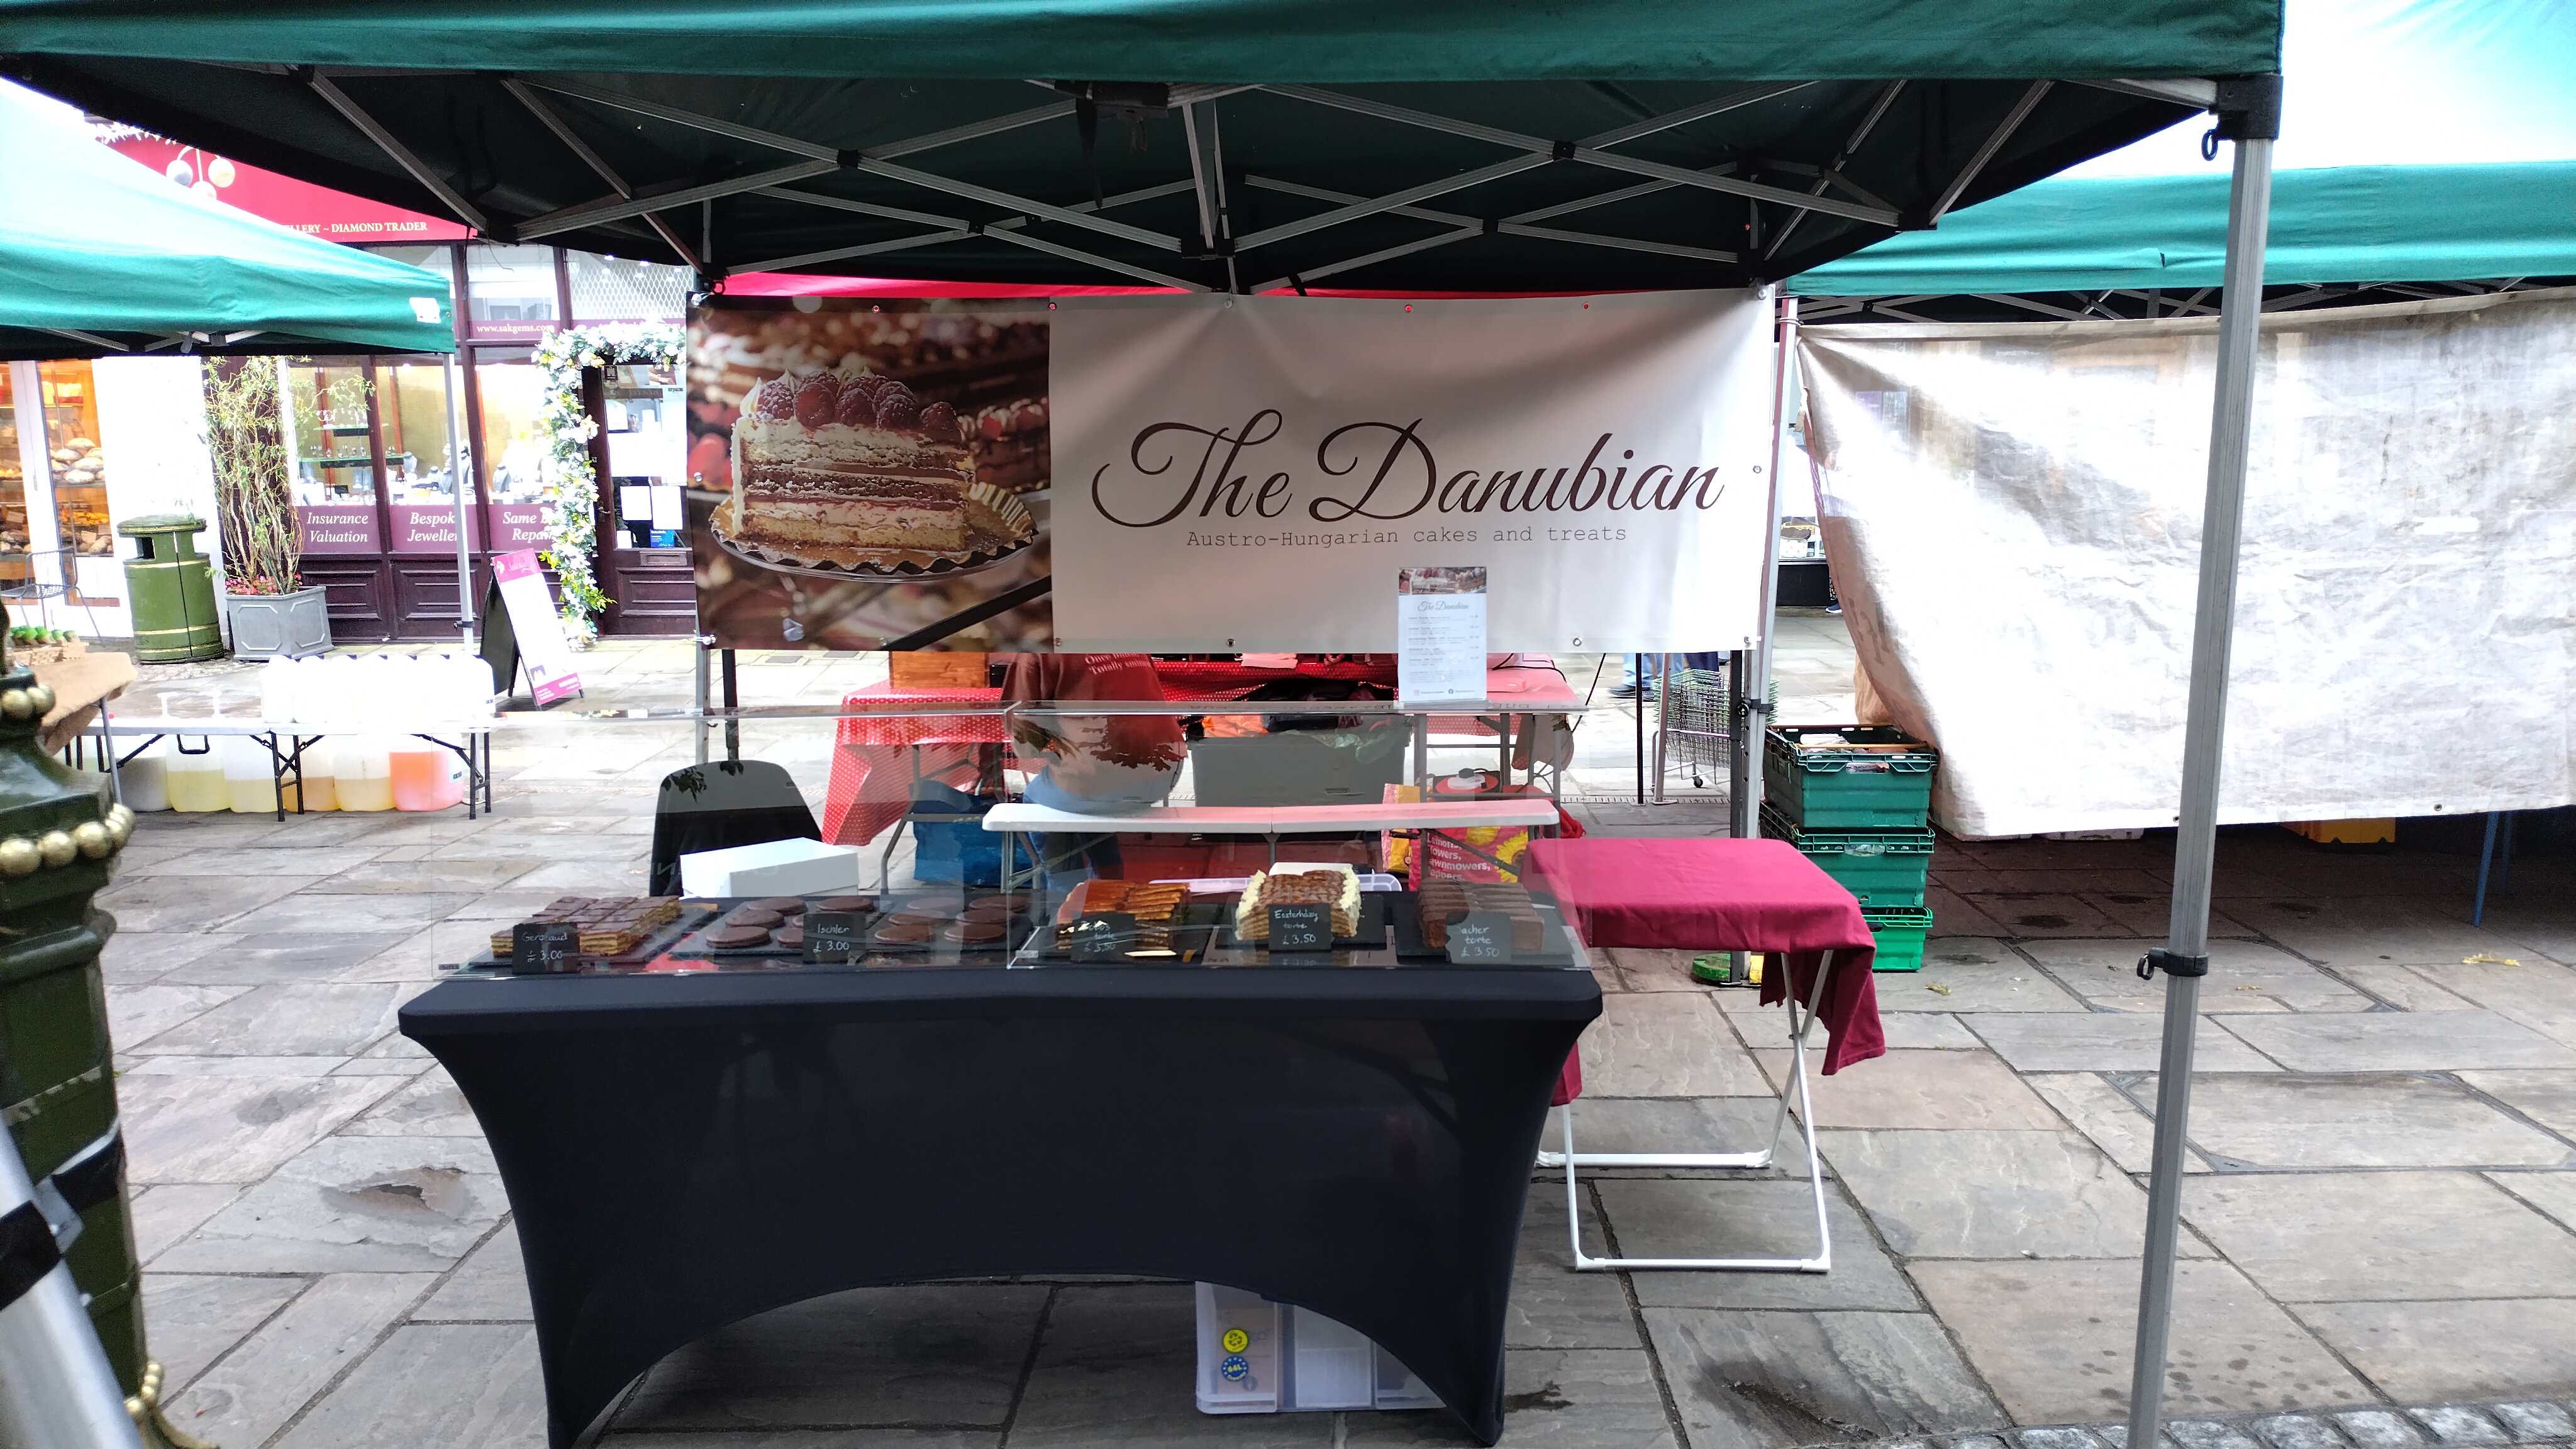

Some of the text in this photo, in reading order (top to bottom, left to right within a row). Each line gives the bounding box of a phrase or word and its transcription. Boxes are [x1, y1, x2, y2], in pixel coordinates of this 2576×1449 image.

[331, 223, 383, 233] DIAMOND
[384, 222, 428, 231] TRADER
[1092, 409, 1724, 527] The Danubian
[307, 512, 369, 525] Insurance
[410, 511, 455, 527] Bespok
[503, 511, 537, 524] Same
[310, 530, 368, 543] Valuation
[1186, 526, 1626, 548] Austro-Hungarian cakes and treats
[1428, 844, 1462, 862] lowers,
[1429, 858, 1491, 871] awnmowers,
[818, 923, 850, 934] Ischler
[1465, 936, 1492, 945] torte
